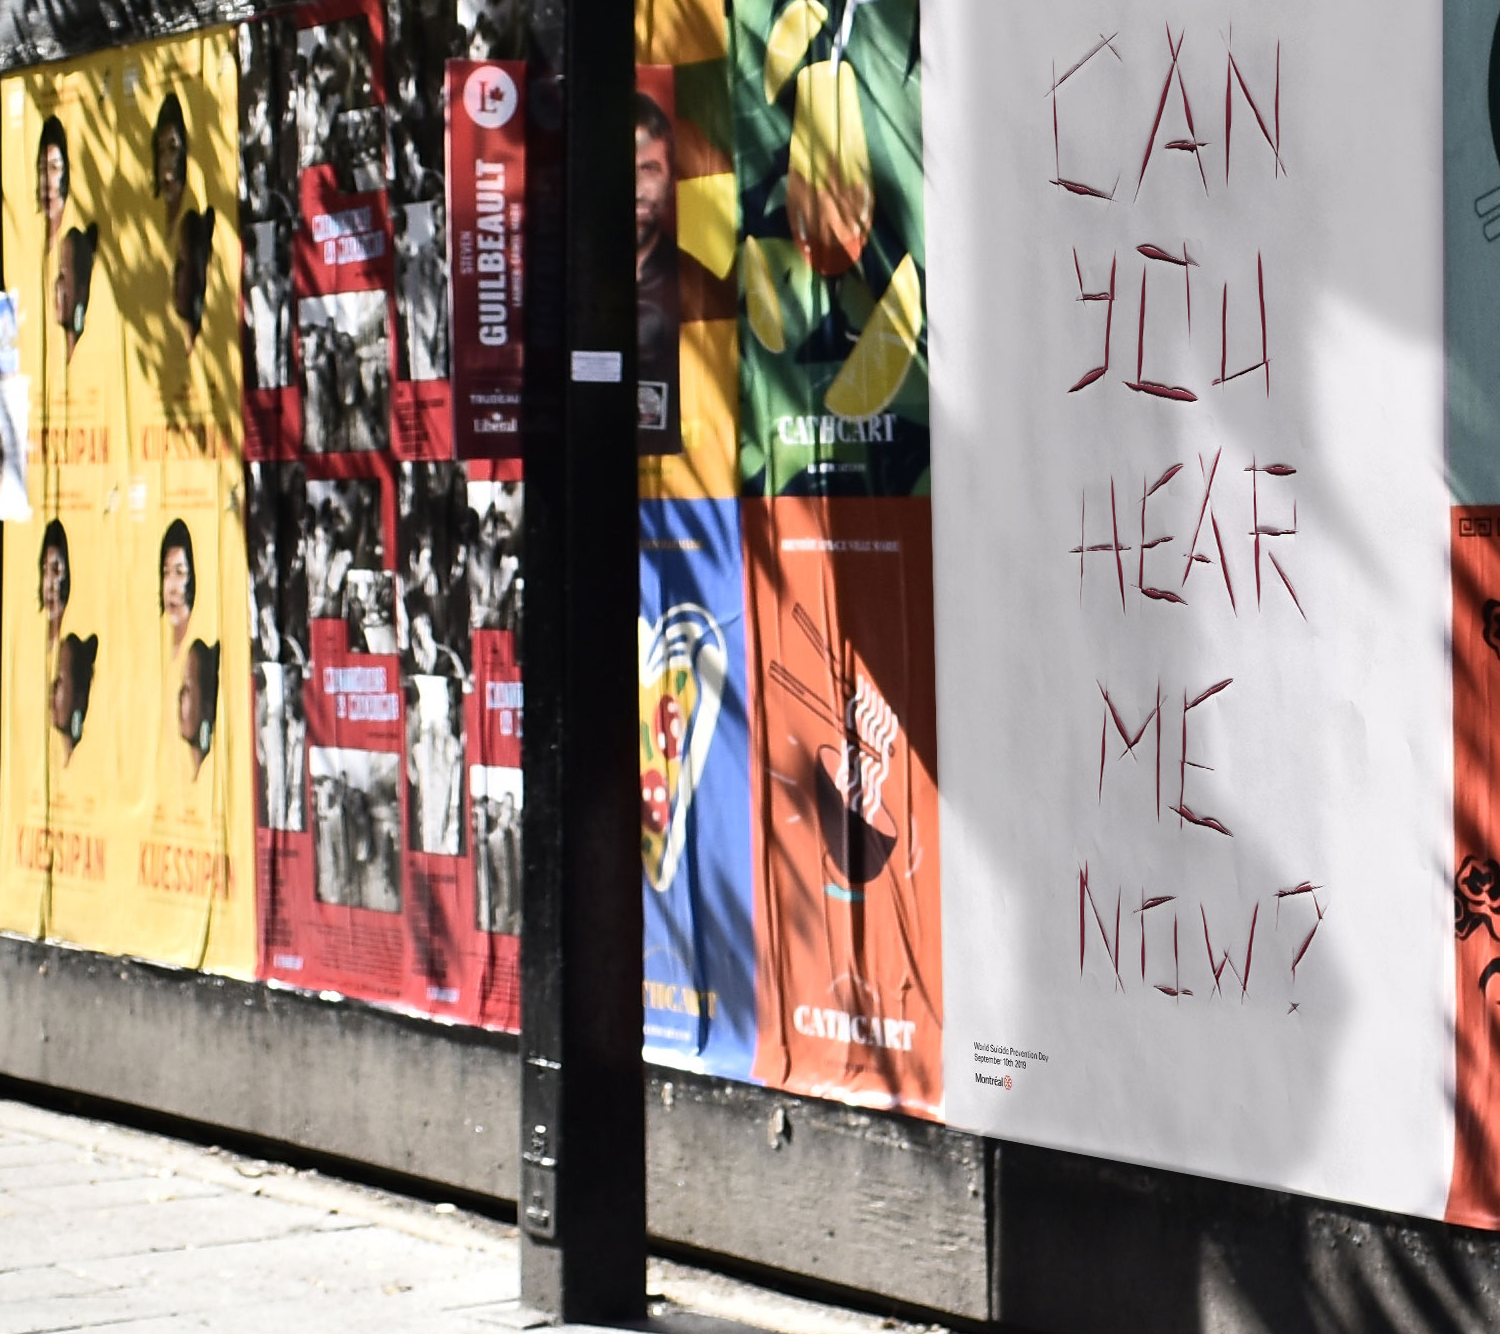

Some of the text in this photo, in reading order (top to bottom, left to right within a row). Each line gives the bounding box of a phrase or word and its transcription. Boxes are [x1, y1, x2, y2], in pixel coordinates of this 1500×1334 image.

[1044, 19, 1288, 204] CAN
[459, 230, 474, 275] STEVEN
[475, 158, 509, 347] GUILBEAULT
[1067, 240, 1274, 403] YOU
[777, 413, 898, 445] CATHCART
[1068, 446, 1308, 621] HEAR
[1095, 675, 1235, 839] ME
[137, 840, 238, 903] KUESSIPAN
[793, 1004, 916, 1052] CATHCART
[973, 1041, 1050, 1063] World Suicide Prevention Day
[973, 1053, 1027, 1070] September 10th 2019
[974, 1072, 1004, 1087] Montréal
